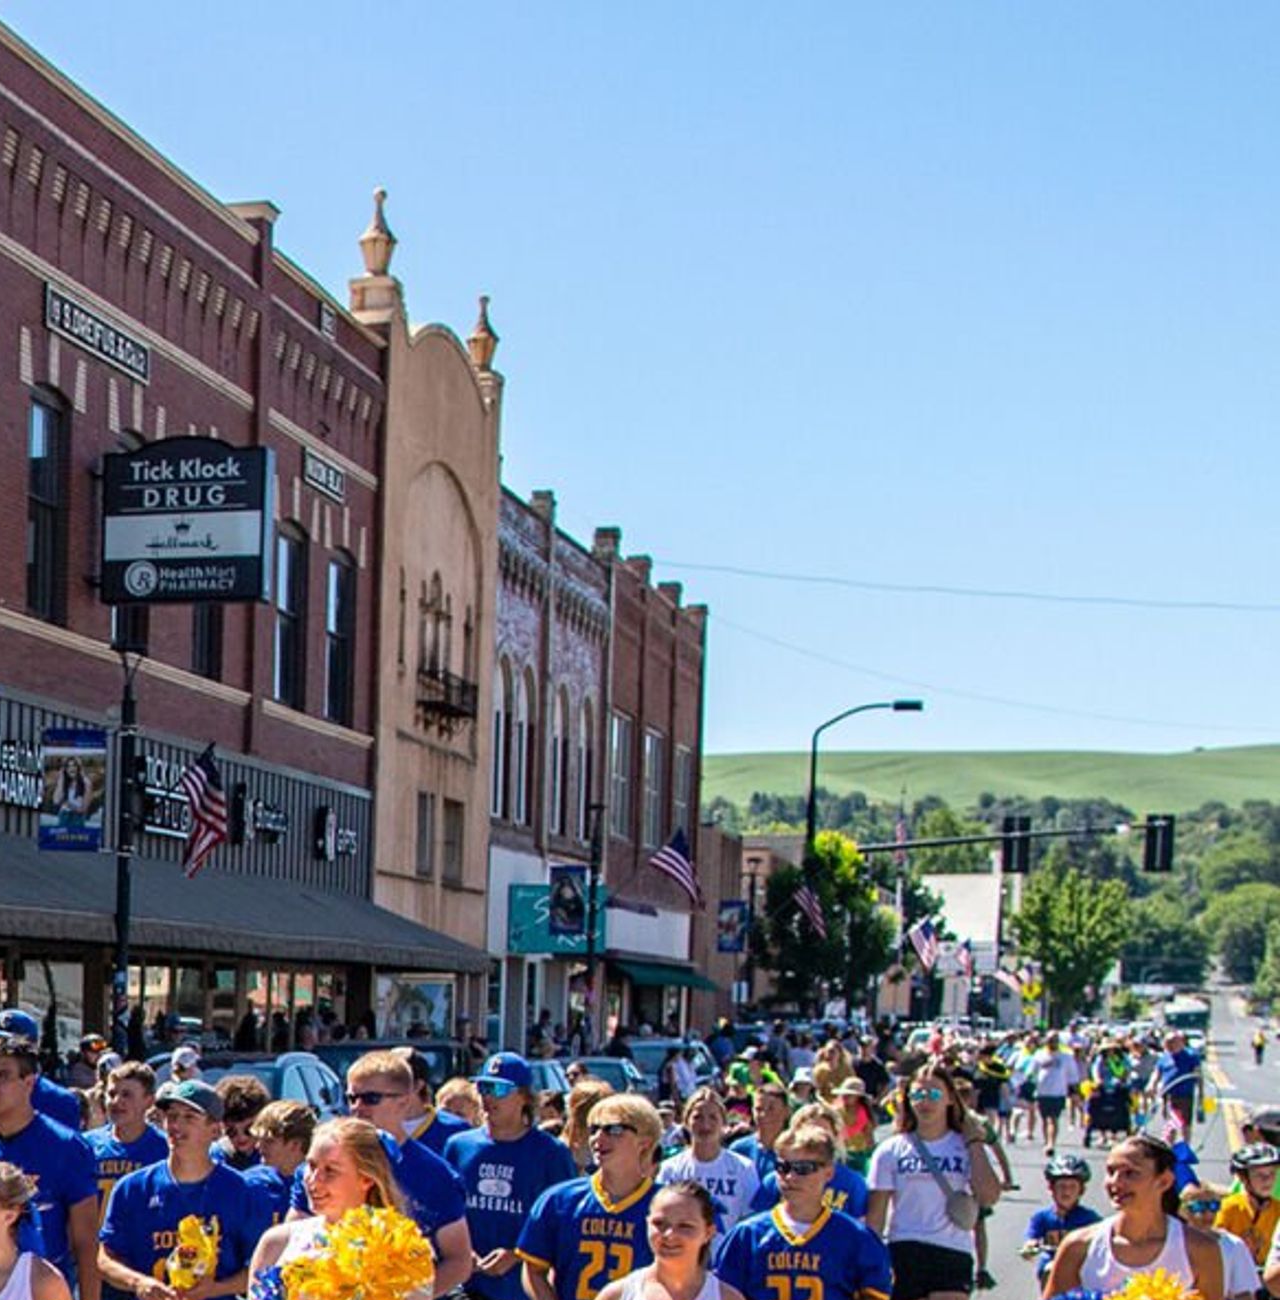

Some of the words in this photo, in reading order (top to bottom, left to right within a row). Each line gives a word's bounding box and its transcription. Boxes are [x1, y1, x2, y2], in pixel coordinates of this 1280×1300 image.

[130, 459, 174, 481] Tick
[179, 456, 240, 480] Klock
[143, 485, 226, 508] DRUG
[145, 533, 220, 557] Hallmark
[159, 580, 235, 591] PHARMACY
[478, 1162, 515, 1181] COLFAX
[581, 1218, 636, 1239] COLFAX
[768, 1252, 821, 1271] COLFAX
